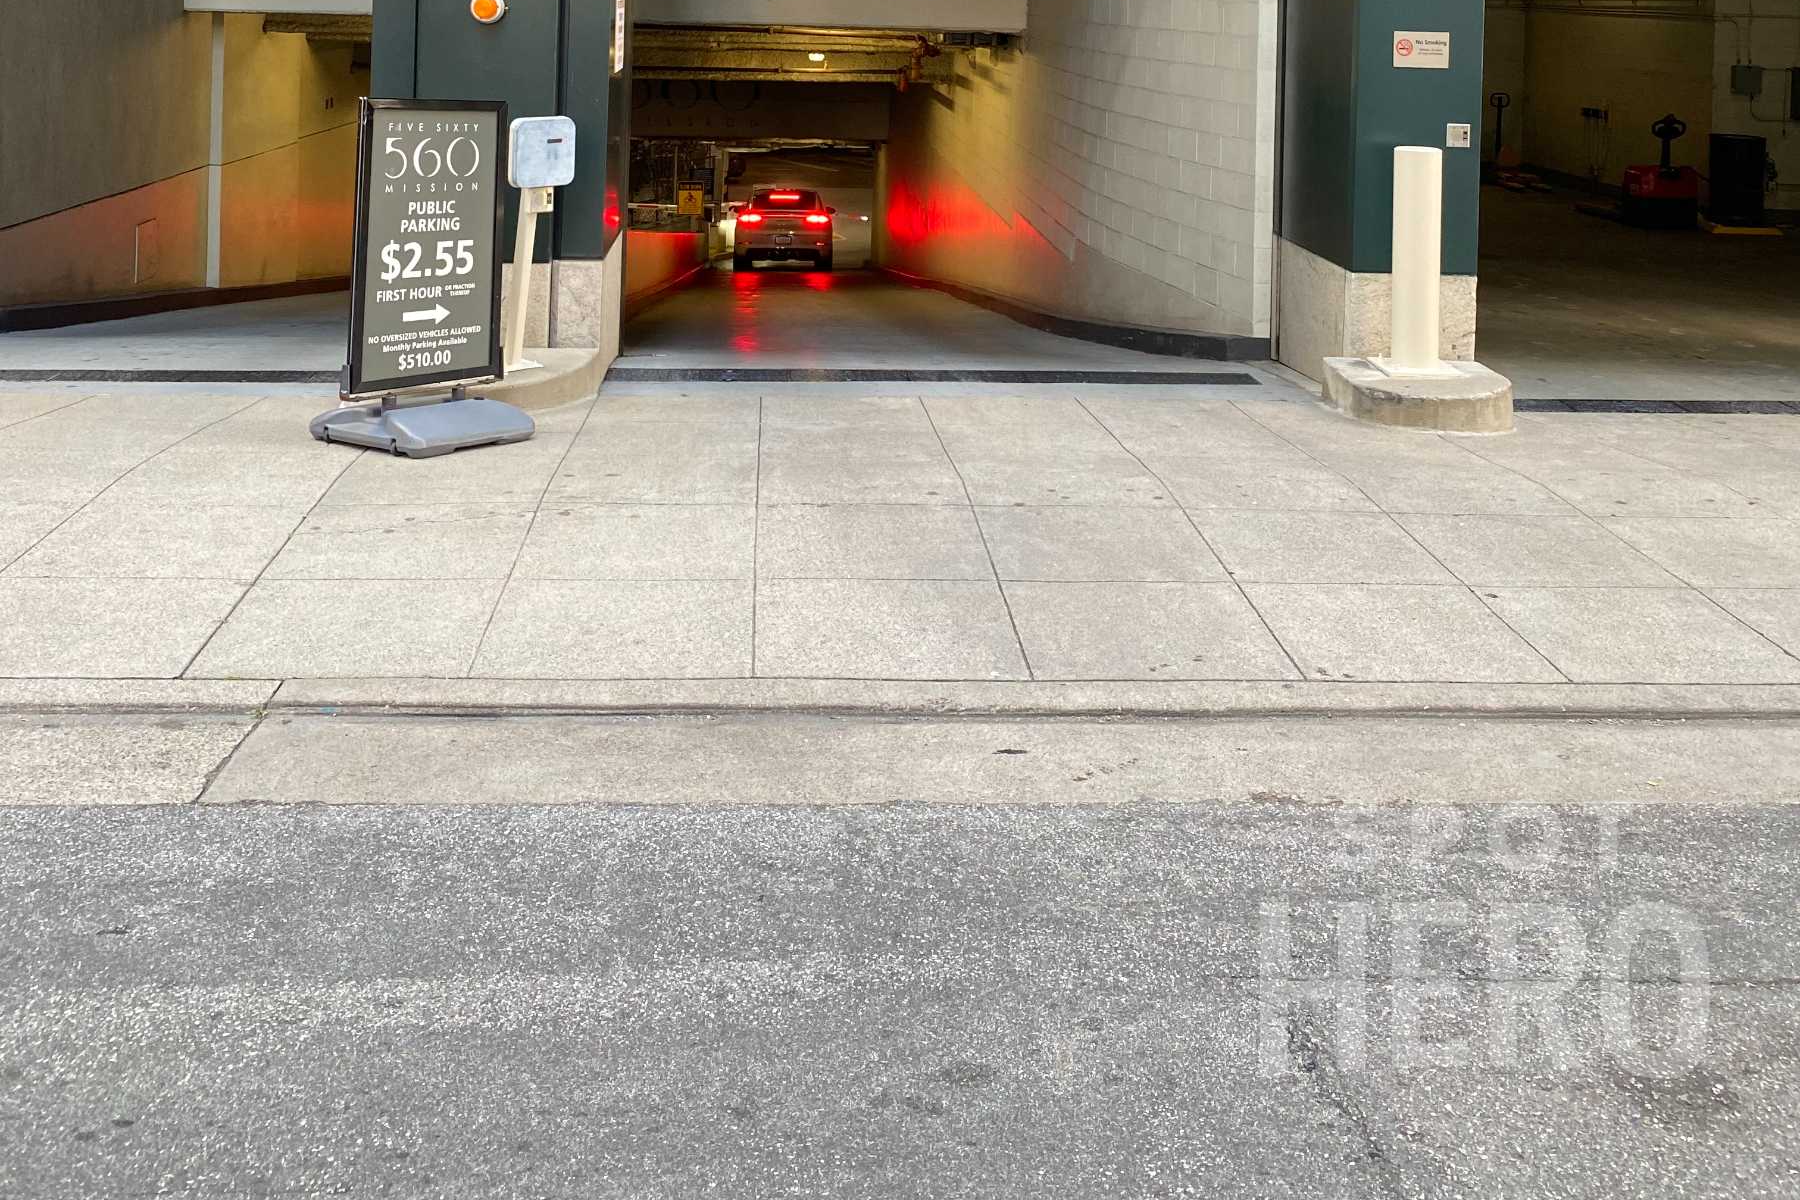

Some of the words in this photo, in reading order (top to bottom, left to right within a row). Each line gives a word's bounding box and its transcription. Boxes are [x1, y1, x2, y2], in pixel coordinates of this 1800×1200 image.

[388, 122, 424, 132] FIVE
[436, 123, 479, 132] SIXTY
[384, 136, 480, 179] 560
[384, 182, 479, 193] MISSION
[408, 200, 456, 215] PUBLIC
[400, 217, 461, 233] PARKING
[380, 239, 474, 285] $2.55
[376, 288, 407, 303] FIRST
[409, 286, 442, 300] HOUR
[367, 336, 380, 344] NO
[381, 332, 418, 343] OVERSIZED
[419, 328, 449, 339] VEHICLES
[450, 325, 481, 335] ALLOWED
[382, 342, 411, 353] Monthly
[412, 340, 437, 349] Parking
[438, 337, 468, 346] Available
[398, 350, 451, 371] $510.00
